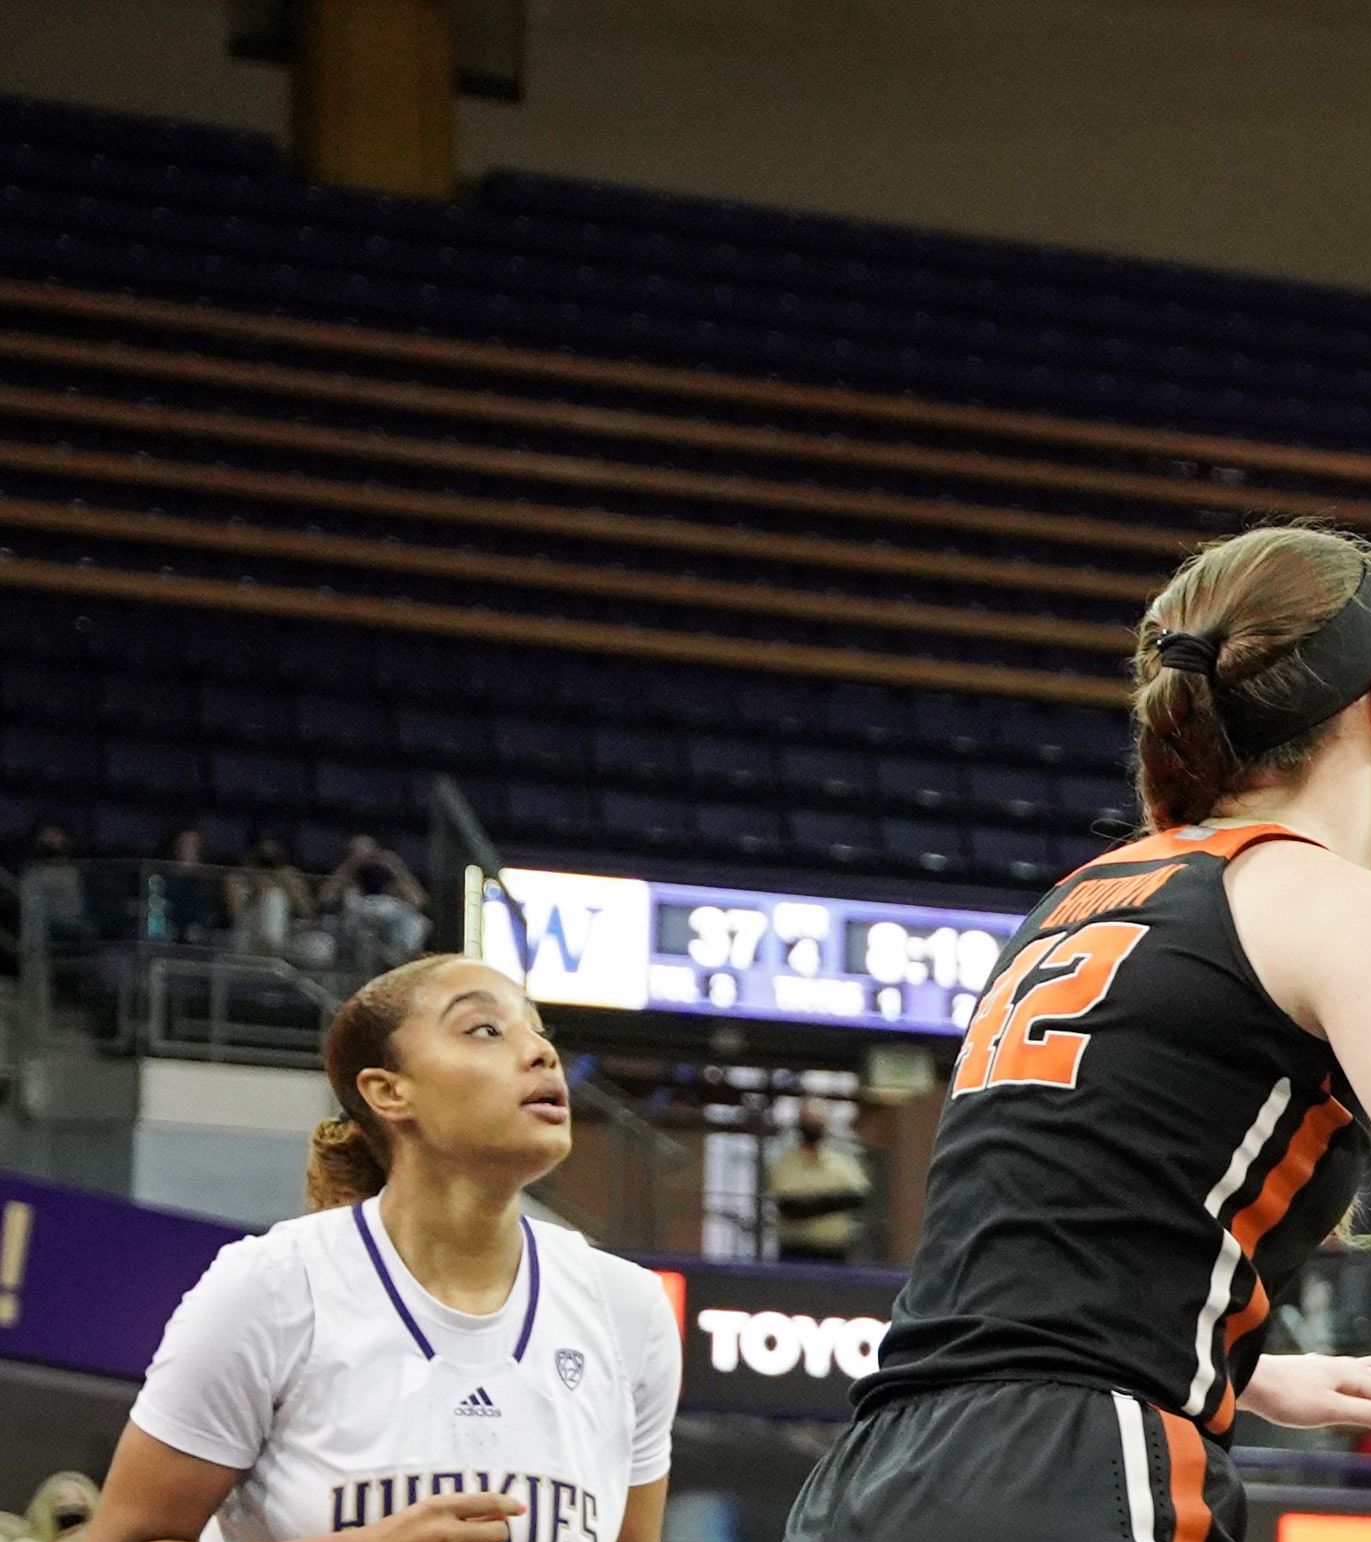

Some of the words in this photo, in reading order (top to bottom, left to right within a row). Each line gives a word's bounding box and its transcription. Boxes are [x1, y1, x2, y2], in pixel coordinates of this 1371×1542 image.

[688, 906, 769, 969] 37
[952, 921, 1150, 1099] 42
[698, 1308, 893, 1380] TOYO
[454, 1405, 502, 1418] adidas
